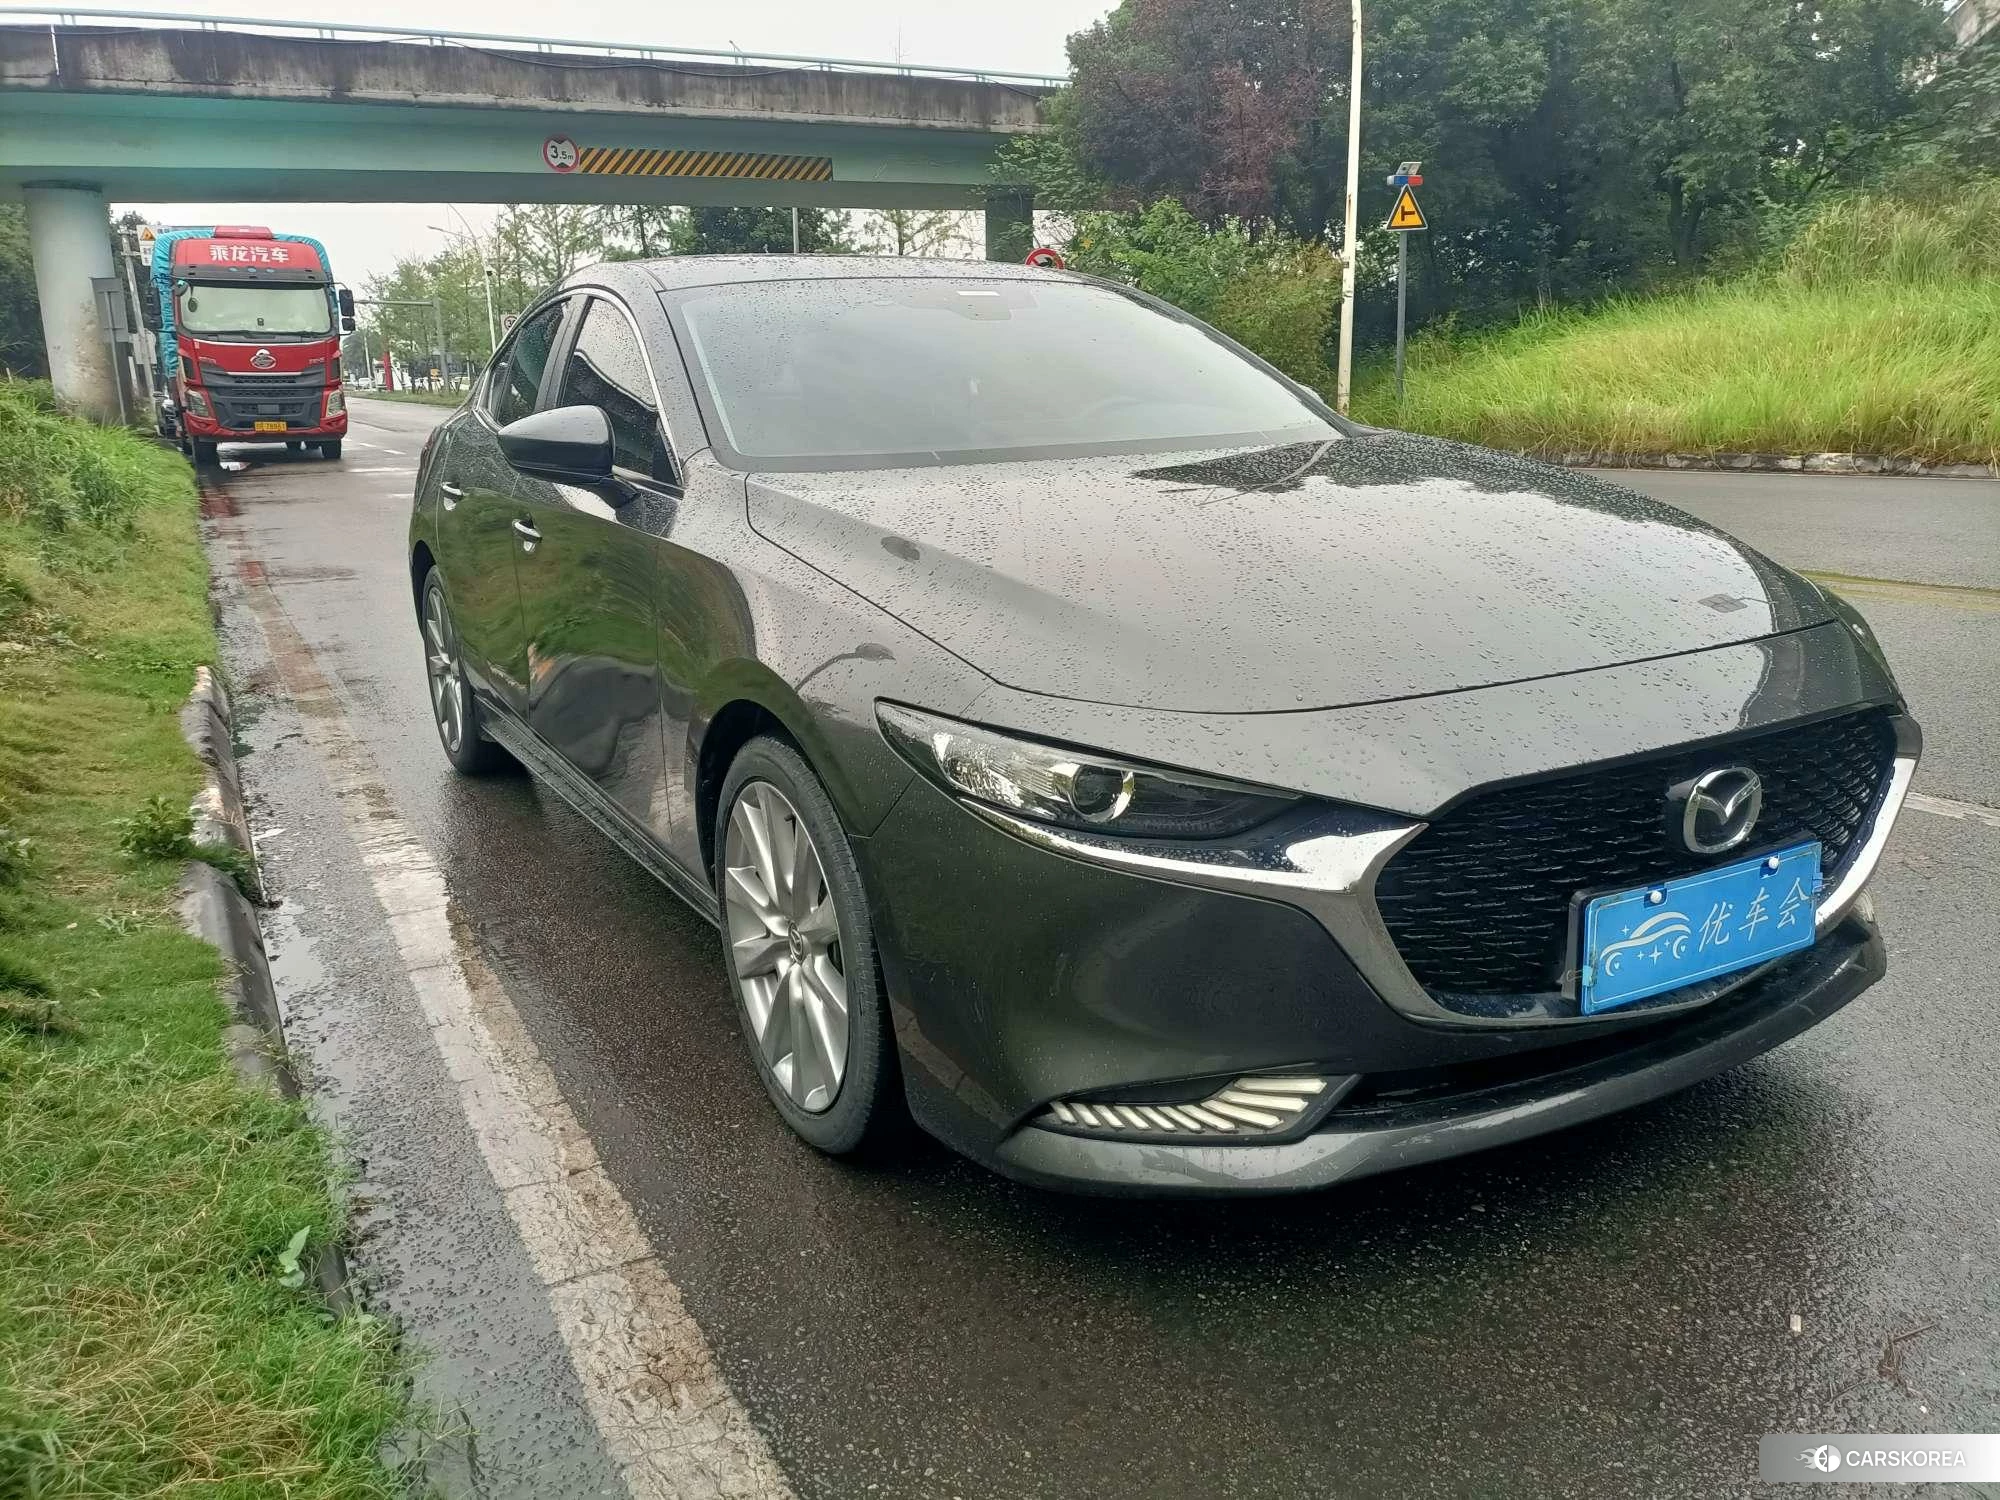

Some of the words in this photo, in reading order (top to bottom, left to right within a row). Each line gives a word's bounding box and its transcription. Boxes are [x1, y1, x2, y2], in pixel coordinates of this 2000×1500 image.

[550, 145, 573, 160] 3.5m
[209, 244, 289, 263] 乘龙汽车
[1699, 877, 1810, 953] 优车会
